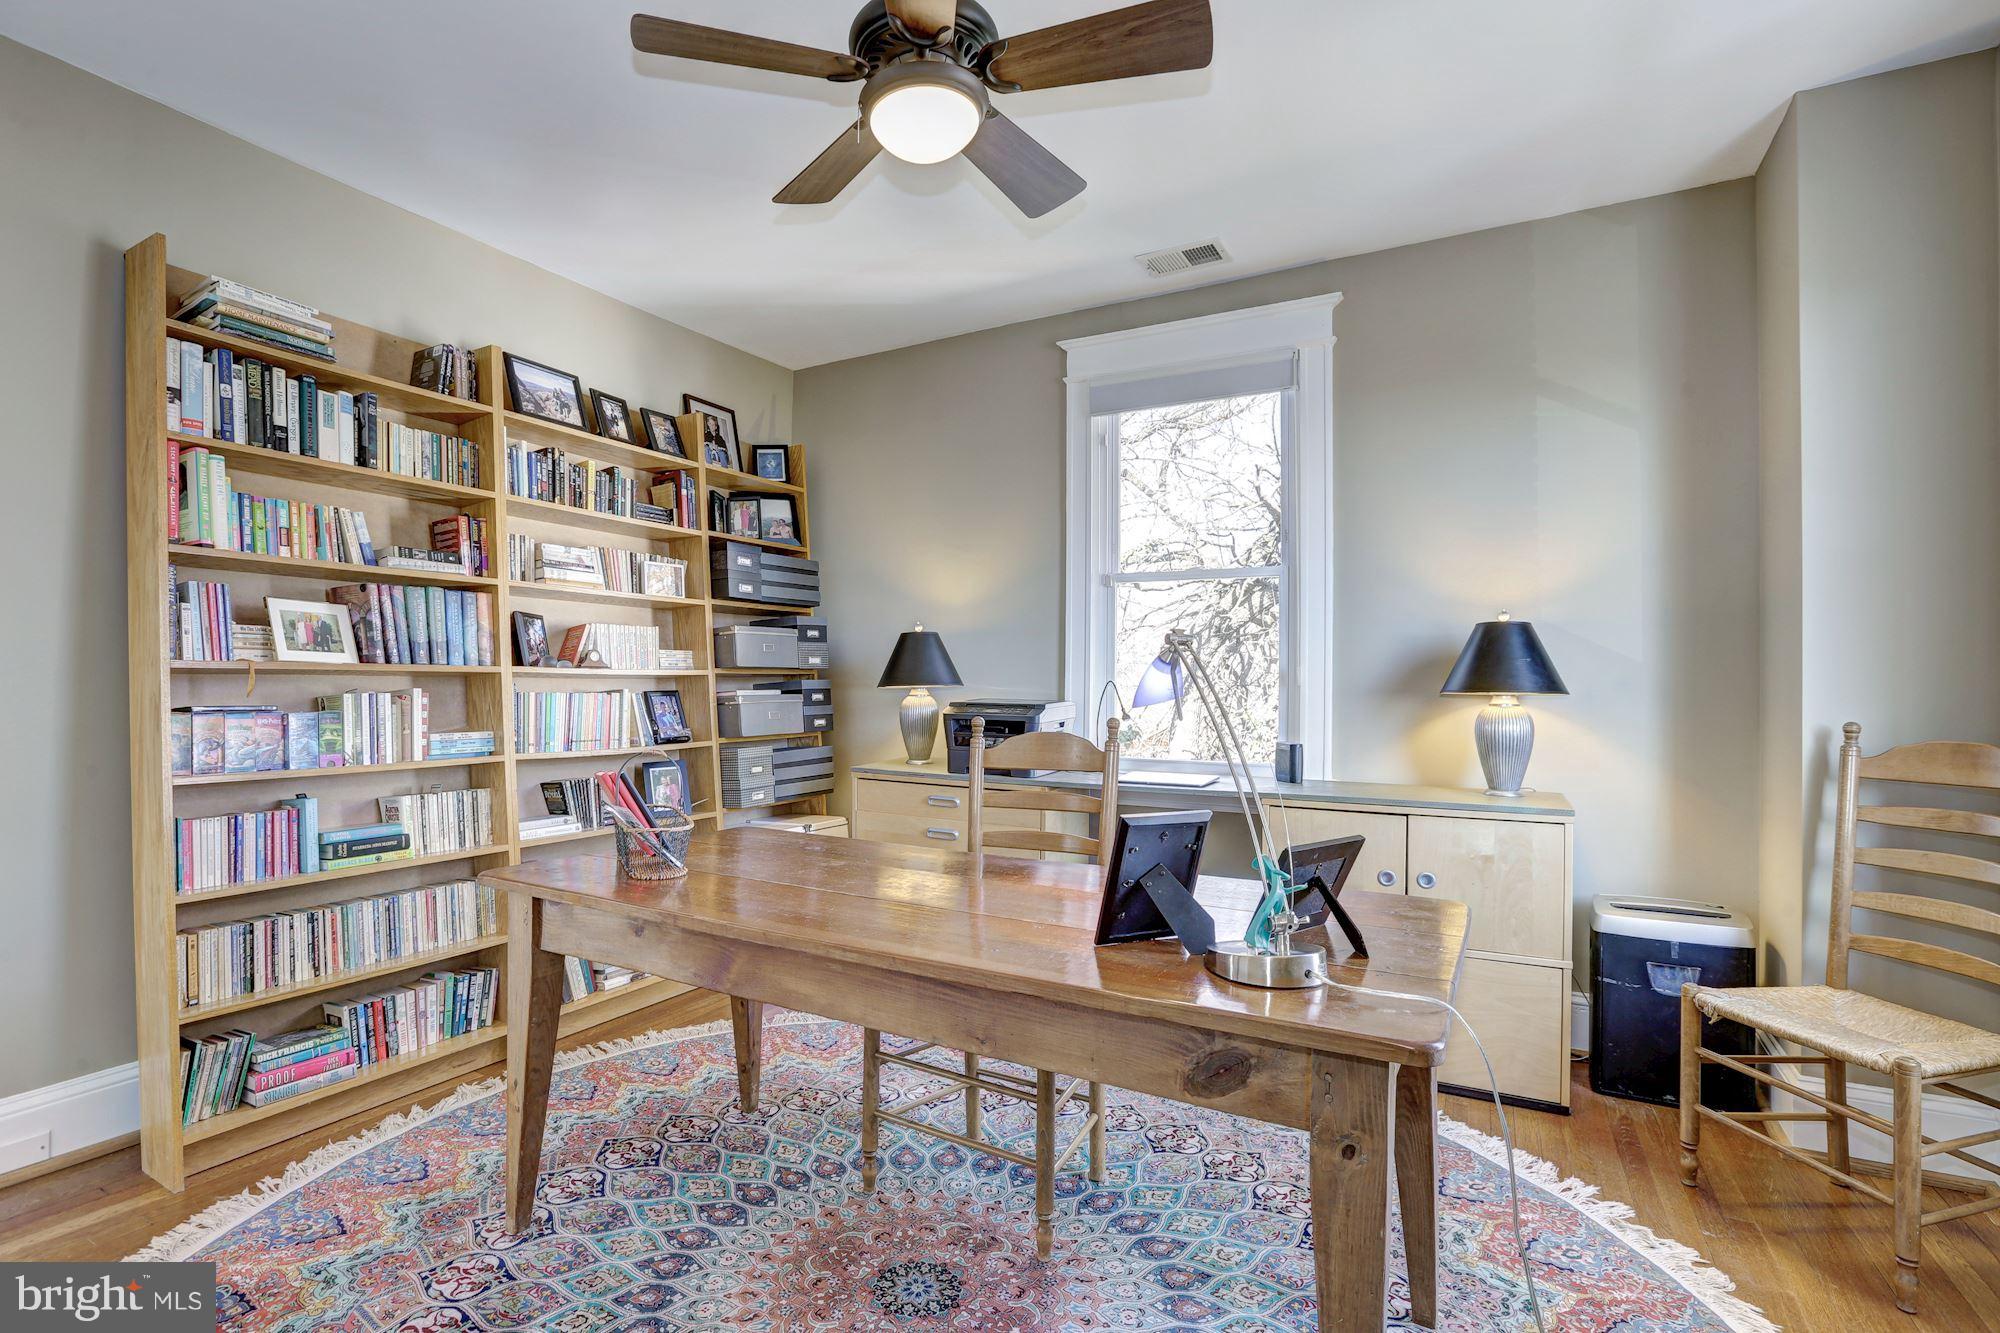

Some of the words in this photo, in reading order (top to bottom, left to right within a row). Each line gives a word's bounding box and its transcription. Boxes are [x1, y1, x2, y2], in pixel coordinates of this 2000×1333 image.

[224, 306, 245, 318] HOME
[248, 312, 298, 333] MAINTENANCE
[248, 364, 257, 388] MEAD
[257, 1052, 278, 1062] DICK
[279, 1040, 314, 1056] FRANCIS
[328, 1056, 340, 1064] DICK
[323, 1061, 344, 1072] FRANCIS
[261, 1068, 296, 1090] PROOF
[264, 1083, 300, 1104] STRAIGHT
